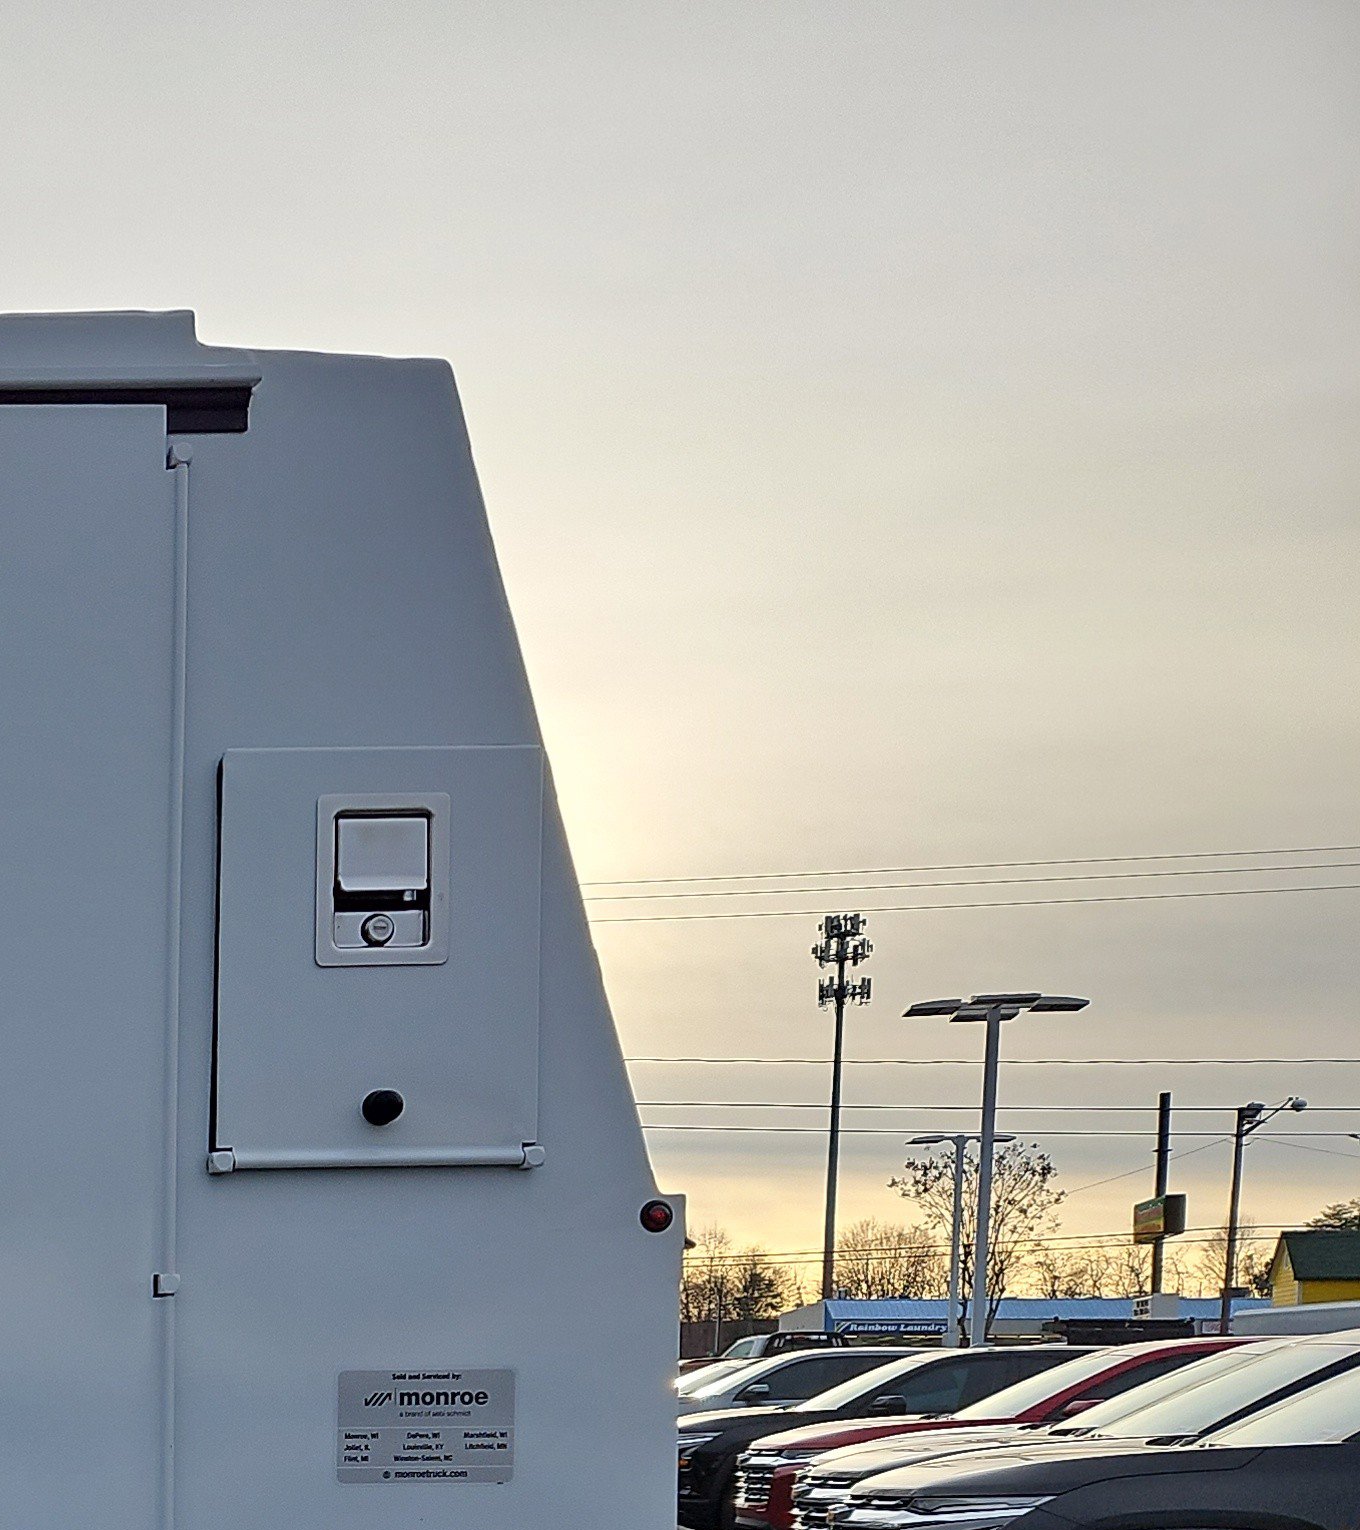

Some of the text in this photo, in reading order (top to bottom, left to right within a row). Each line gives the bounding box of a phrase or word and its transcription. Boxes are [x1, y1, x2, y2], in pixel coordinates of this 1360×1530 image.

[900, 1324, 948, 1332] Laundry
[399, 1391, 489, 1406] monroe
[345, 1432, 370, 1440] Monroe,
[464, 1431, 498, 1439] Marshfield,
[344, 1455, 359, 1463] Flint,
[393, 1454, 442, 1462] Winston-Salem,
[394, 1470, 468, 1478] monroetruck.com
